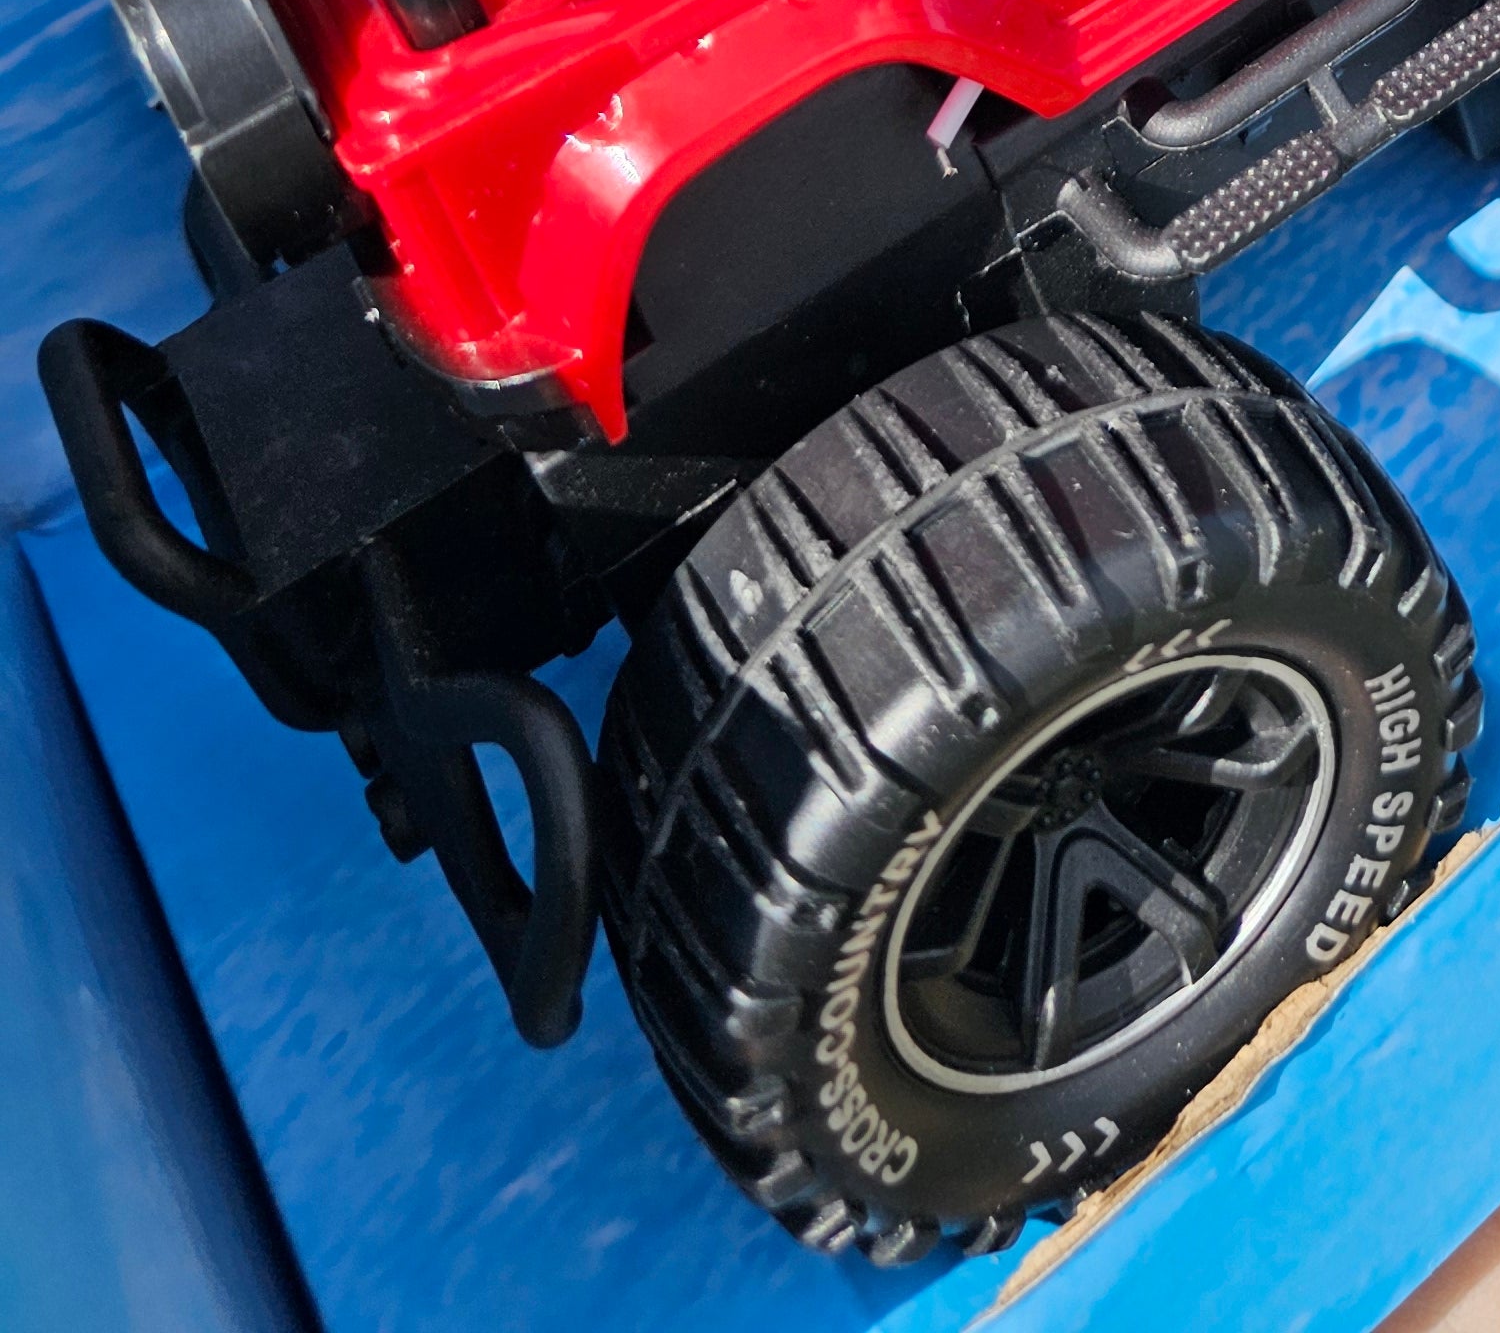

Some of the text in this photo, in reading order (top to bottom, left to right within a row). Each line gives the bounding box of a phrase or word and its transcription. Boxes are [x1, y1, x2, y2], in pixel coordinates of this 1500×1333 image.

[1305, 662, 1423, 962] HIGH SPEED
[815, 809, 943, 1186] CROSS-COUNTRY
